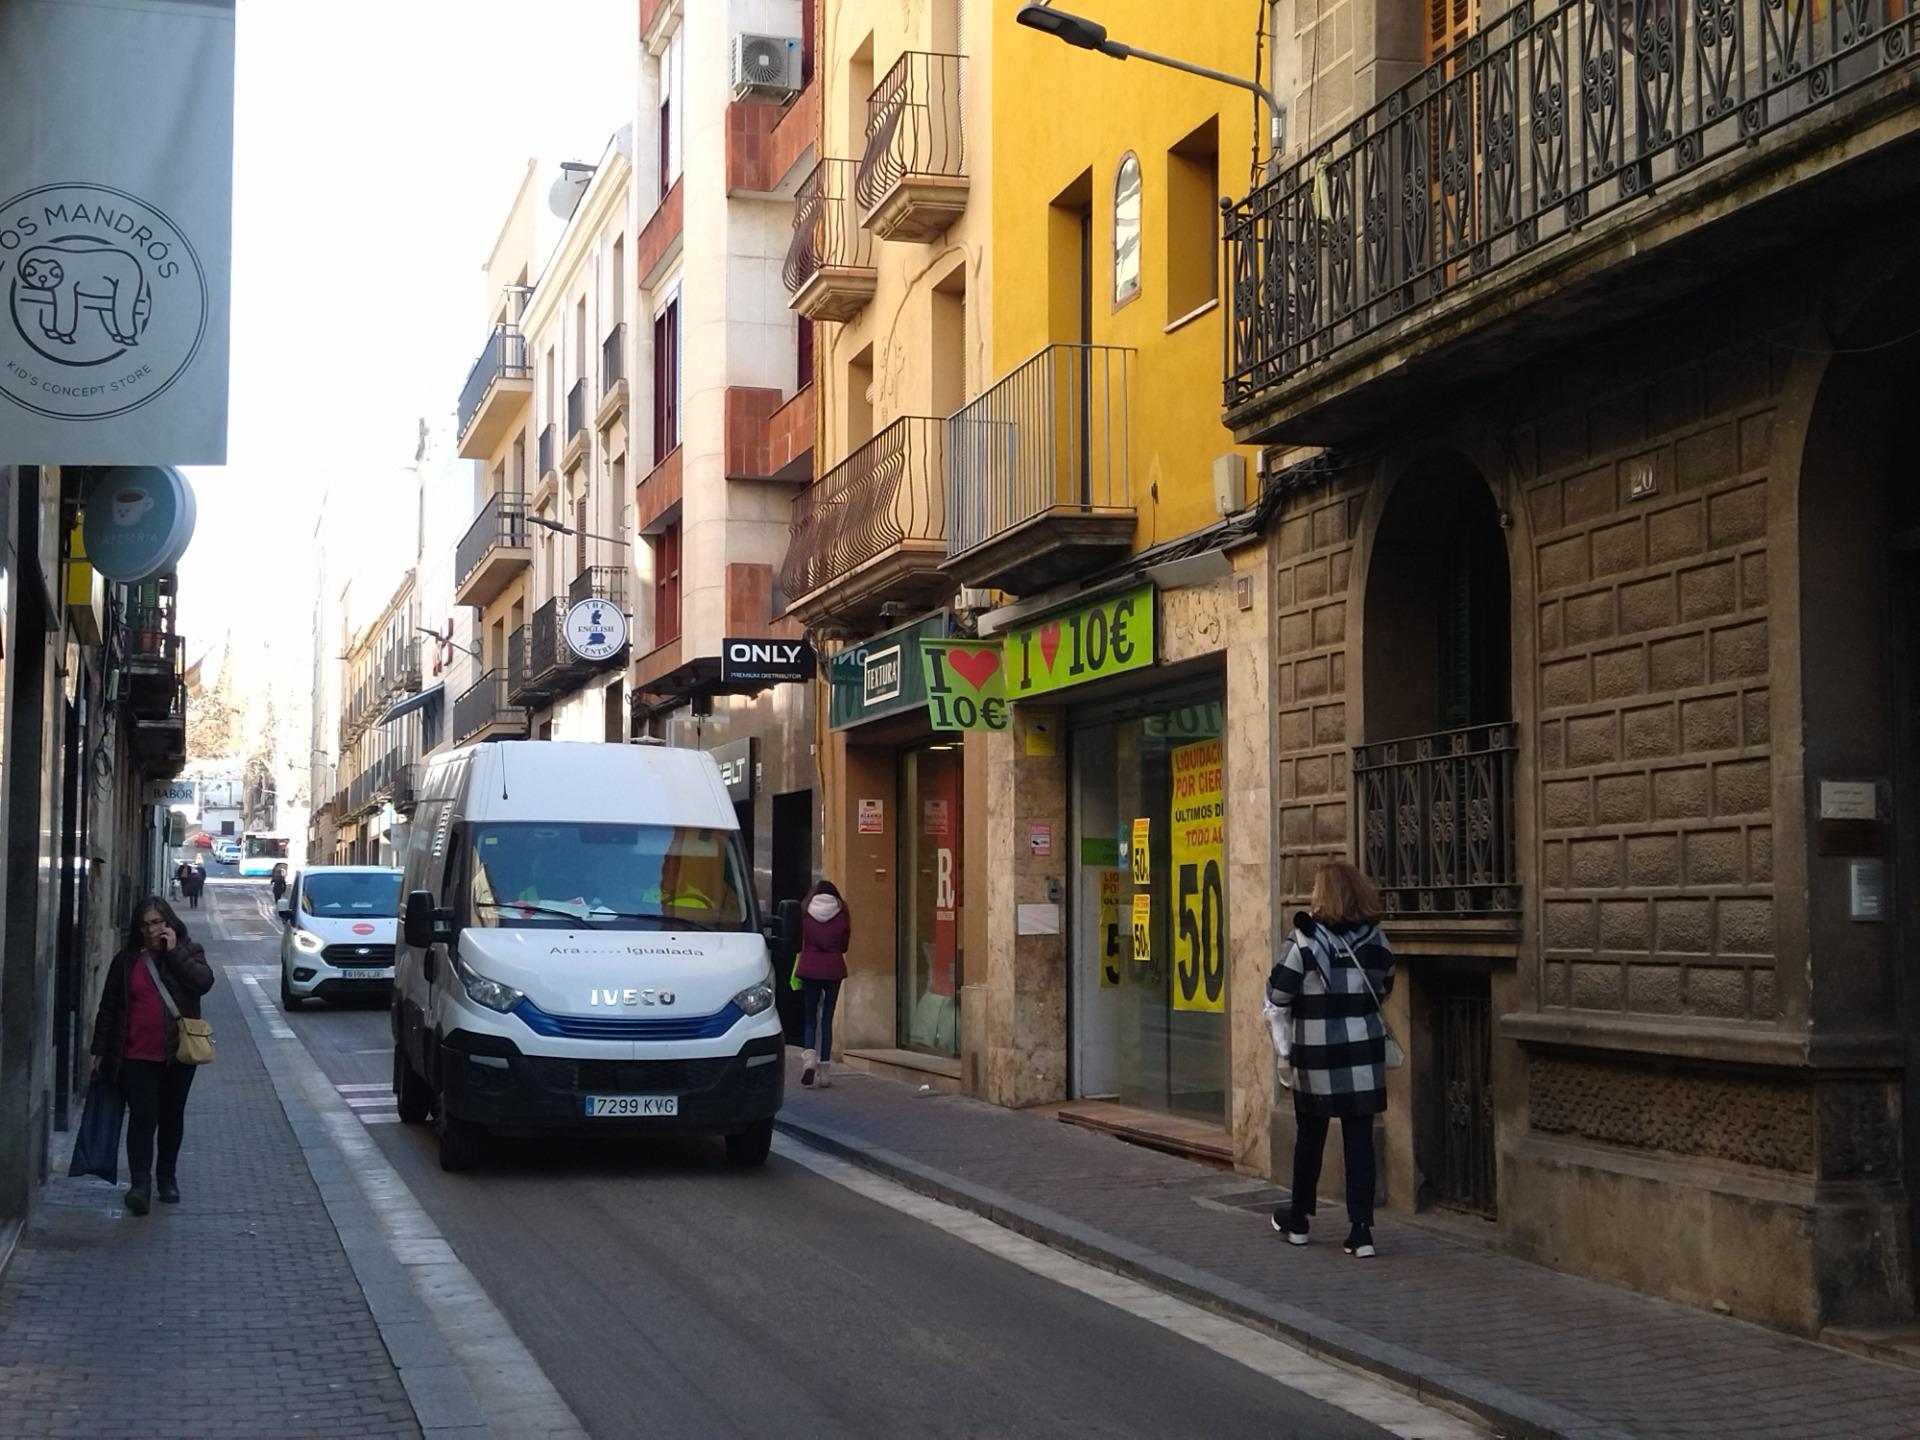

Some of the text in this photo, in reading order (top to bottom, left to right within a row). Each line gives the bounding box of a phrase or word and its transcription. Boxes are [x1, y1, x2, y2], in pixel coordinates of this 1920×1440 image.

[44, 203, 180, 279] MANDRÓS
[7, 360, 152, 398] KID'S CONCEPT STORE
[1632, 464, 1653, 494] 20
[584, 601, 606, 610] THE
[578, 625, 614, 633] ENGLISH
[1069, 599, 1134, 677] 10€
[578, 644, 614, 656] CENTRE
[730, 644, 802, 664] ONLY
[867, 660, 897, 691] TEXTURA
[930, 695, 1008, 730] 10€
[153, 788, 193, 799] BABOR
[1175, 775, 1196, 799] POR
[1175, 803, 1213, 823] ÚLTIMOS
[1186, 827, 1210, 848] TODO
[1178, 859, 1224, 1003] 50
[626, 947, 704, 956] Igualada
[591, 988, 676, 1007] IVECO
[597, 1098, 674, 1114] 7299 KVG
